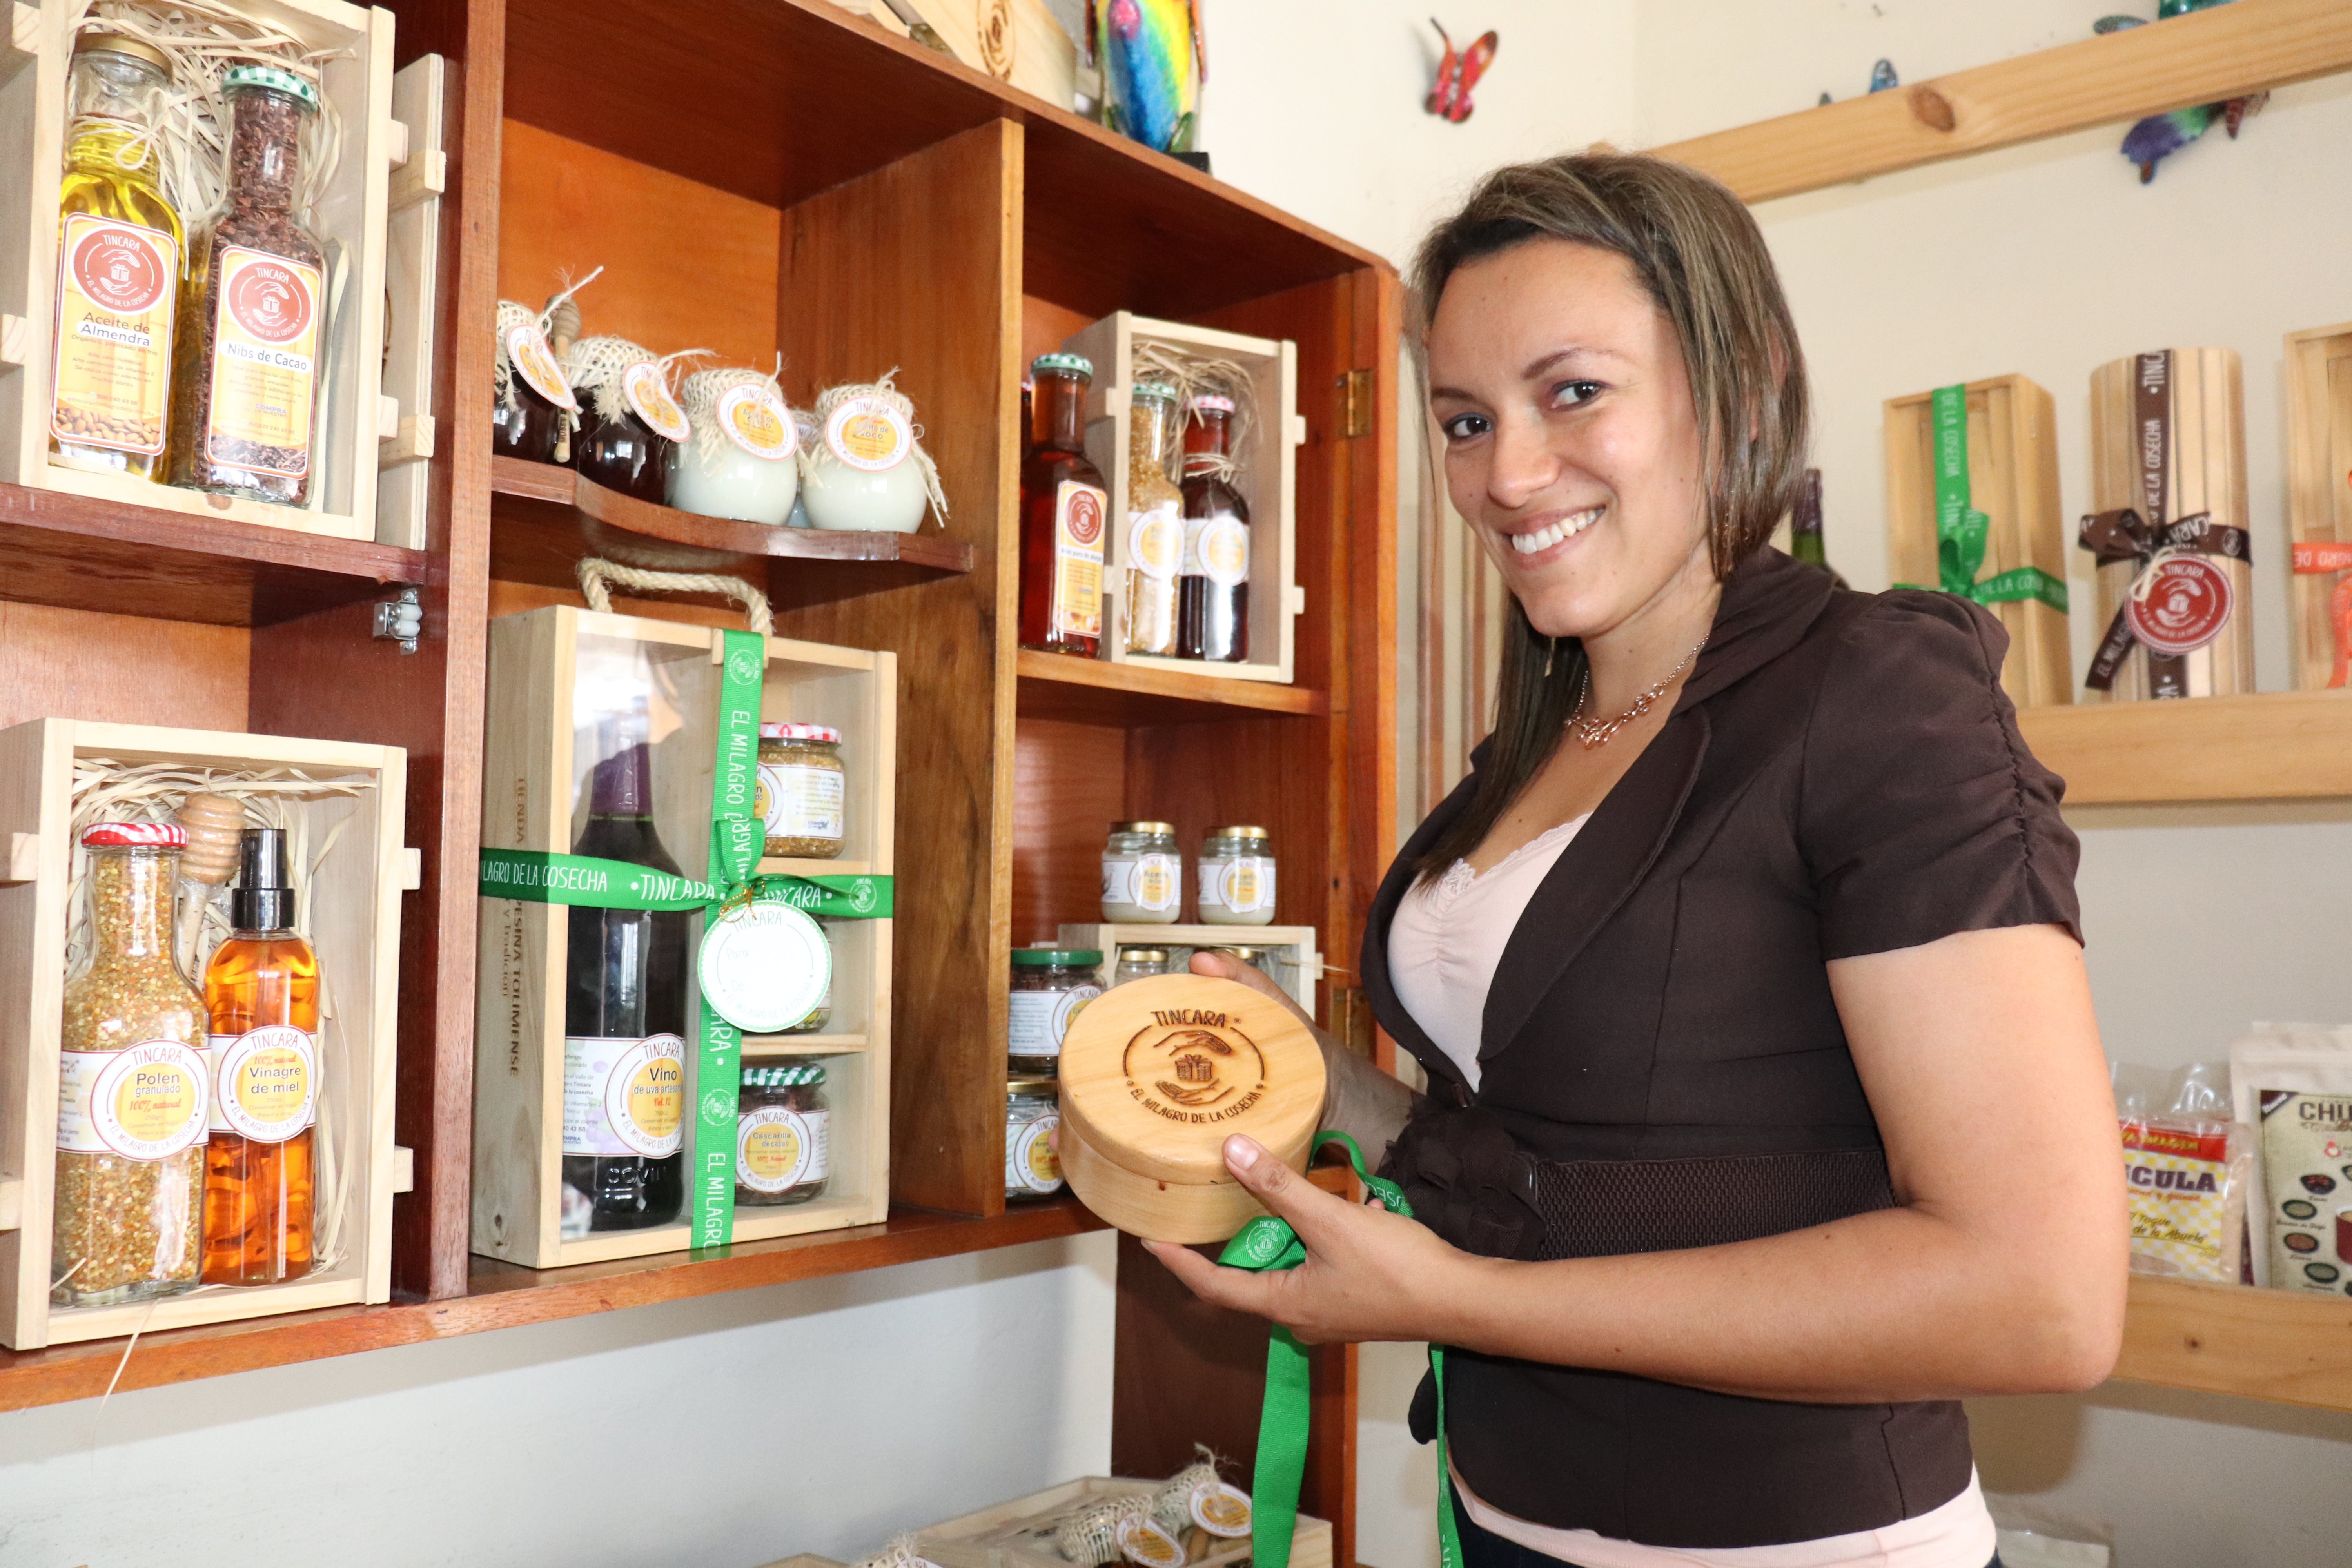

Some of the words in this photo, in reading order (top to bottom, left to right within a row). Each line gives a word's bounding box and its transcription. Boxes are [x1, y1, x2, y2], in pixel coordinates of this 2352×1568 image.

[103, 234, 140, 252] TINCARA
[256, 267, 289, 284] TINCARA
[92, 287, 113, 304] MILAGRO
[131, 292, 150, 305] COSECHA
[83, 312, 129, 329] Aceite
[134, 323, 150, 334] de
[246, 318, 265, 335] MILAGRO
[281, 322, 298, 336] COSECHA
[80, 324, 150, 346] Almendra
[105, 342, 135, 351] prensado
[227, 343, 254, 359] Nibs
[257, 350, 270, 362] de
[275, 353, 307, 370] Cacao
[742, 388, 772, 407] TINCRA
[255, 403, 287, 414] COMPRA
[855, 402, 889, 417] TINRA
[2145, 420, 2161, 469] COSECHA
[2167, 564, 2205, 578] TINCARA
[730, 711, 750, 730] EL
[725, 733, 750, 805] MILAGRO
[516, 775, 526, 844] TIENDA
[513, 863, 526, 885] DE
[527, 864, 538, 886] LA
[543, 866, 608, 893] COSECHA
[732, 911, 782, 933] TINCARA
[726, 947, 748, 960] Para
[731, 980, 744, 992] De
[735, 1002, 767, 1020] MILAGRO
[769, 1011, 779, 1019] DE
[780, 1006, 791, 1016] LA
[790, 982, 813, 1009] COSECHA
[510, 968, 521, 1076] TOLIMENSE
[1150, 1009, 1226, 1027] TINCARA
[249, 1033, 298, 1050] TINCARA
[131, 1047, 182, 1066] TINCARA
[254, 1056, 273, 1066] 100%
[274, 1054, 297, 1064] natural
[642, 1042, 680, 1060] TINCARA
[136, 1073, 180, 1085] Polen
[249, 1067, 301, 1079] Vinagre
[649, 1067, 677, 1082] Vino
[135, 1084, 180, 1098] granulado
[251, 1083, 269, 1094] de
[273, 1081, 299, 1093] miel
[634, 1084, 644, 1094] de
[129, 1100, 151, 1113] 100%
[152, 1098, 181, 1109] natural
[666, 1097, 671, 1106] 12
[1130, 1088, 1145, 1100] EL
[1141, 1097, 1187, 1122] MILAGRO
[1191, 1113, 1207, 1123] DE
[1209, 1111, 1225, 1122] LA
[1224, 1091, 1261, 1117] COSECHA
[232, 1106, 241, 1116] EL
[238, 1114, 268, 1133] MILAGRO
[270, 1125, 279, 1133] DE
[282, 1122, 291, 1132] LA
[291, 1102, 309, 1126] COSECHA
[754, 1112, 790, 1125] TINCARA
[109, 1125, 119, 1136] EL
[117, 1133, 147, 1152] MILAGRO
[149, 1144, 159, 1152] DE
[161, 1142, 171, 1151] LA
[172, 1120, 196, 1145] COSECHA
[623, 1120, 632, 1131] EL
[630, 1129, 656, 1149] MILAGRO
[658, 1140, 665, 1149] DE
[666, 1138, 672, 1147] LA
[706, 1154, 726, 1173] EL
[746, 1172, 766, 1187] MILAGRO
[783, 1165, 799, 1183] COSECHA
[2125, 1163, 2218, 1194] CULA
[1259, 1220, 1279, 1230] TINCARA
[2133, 1225, 2148, 1235] de
[2151, 1227, 2161, 1238] la
